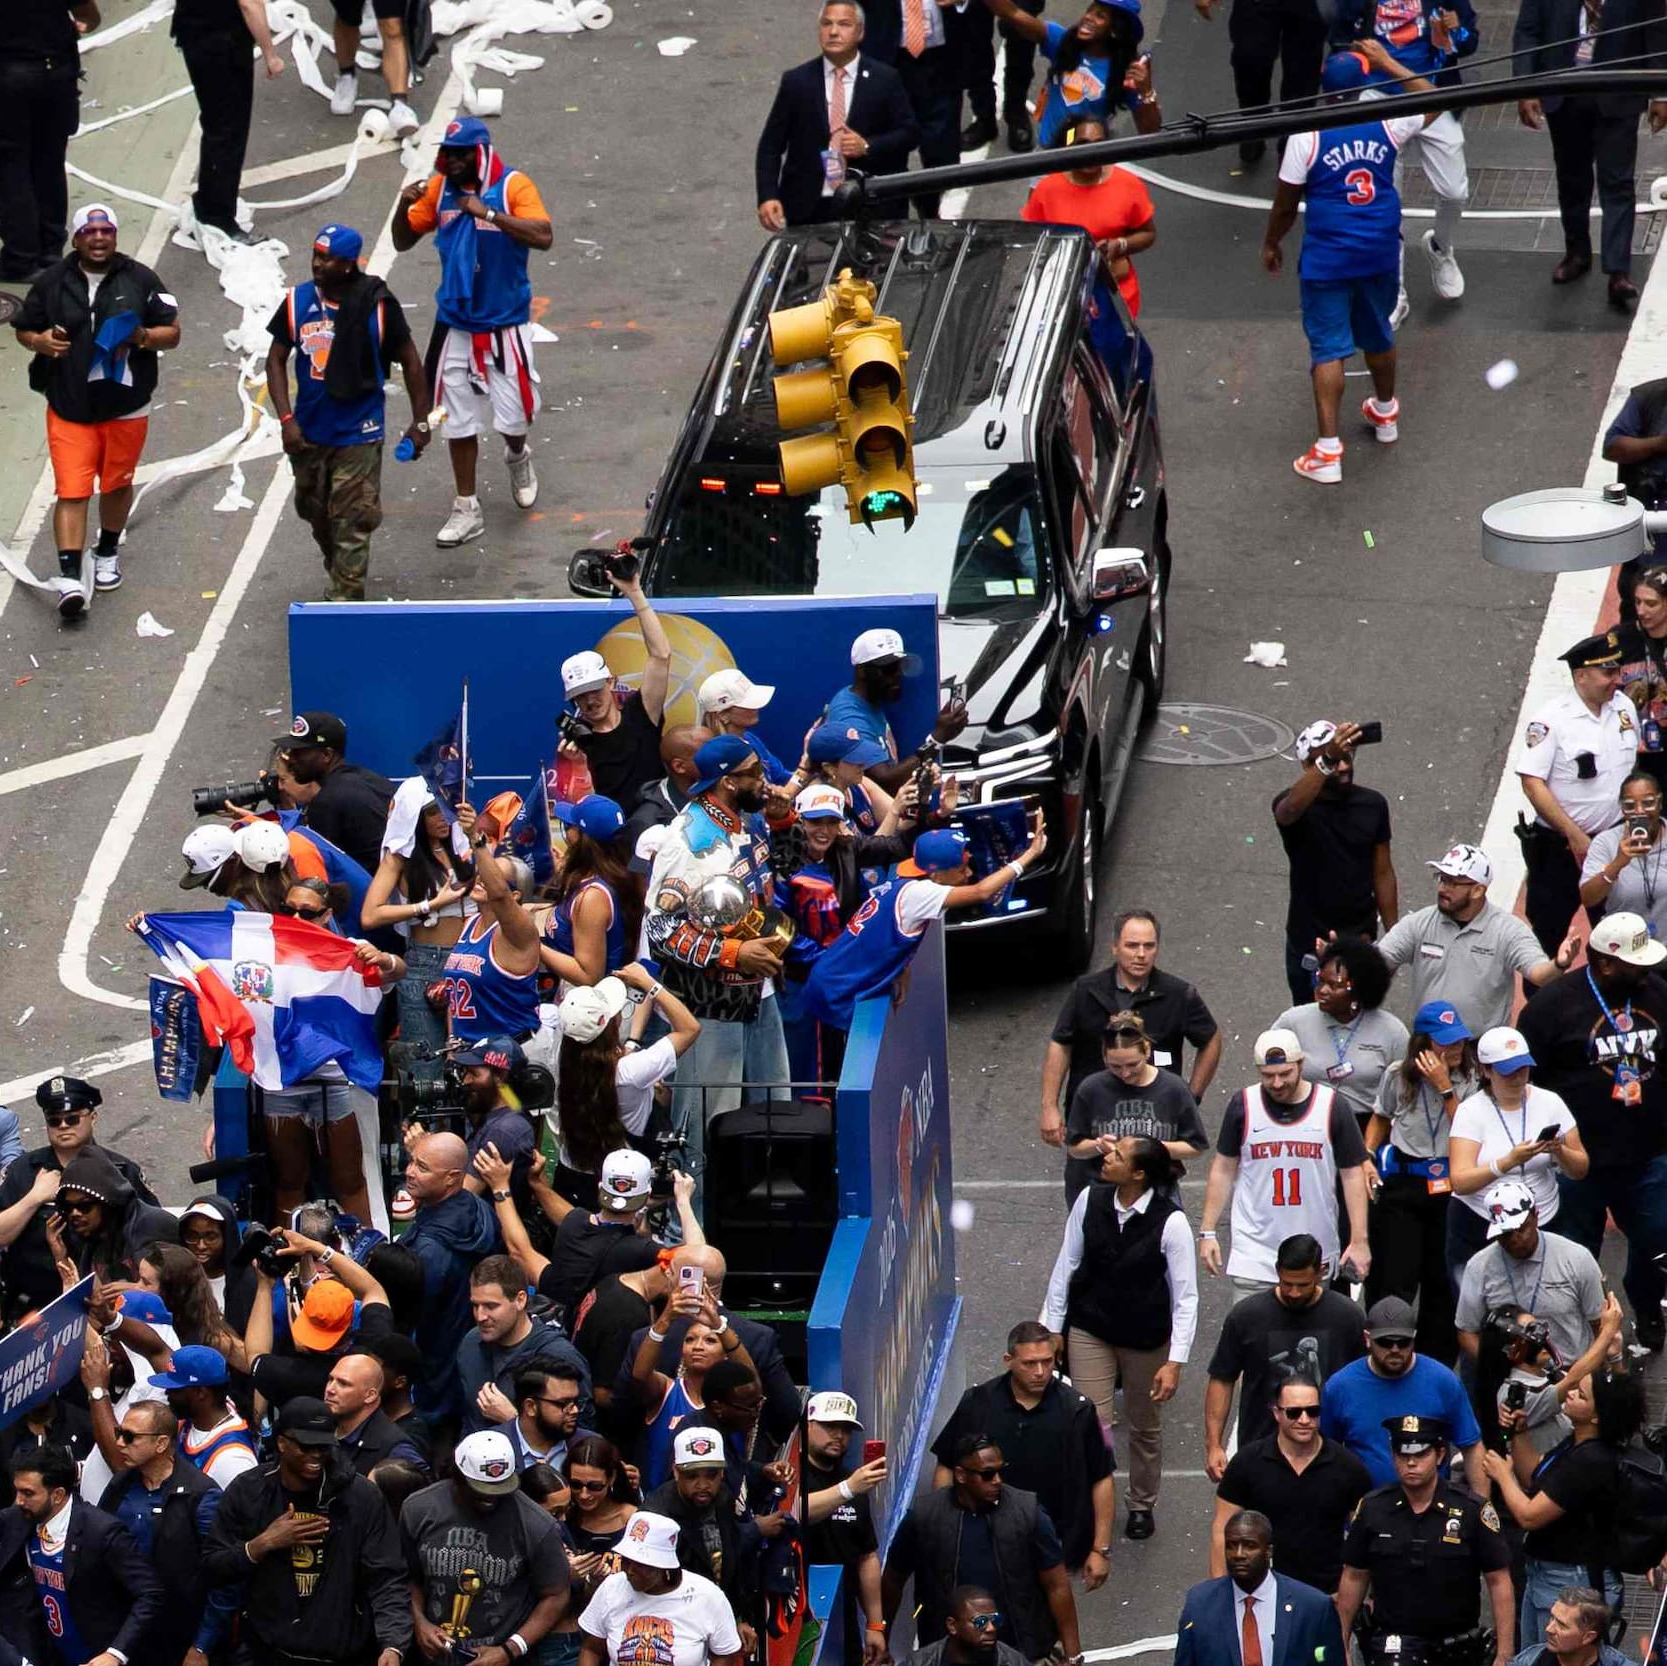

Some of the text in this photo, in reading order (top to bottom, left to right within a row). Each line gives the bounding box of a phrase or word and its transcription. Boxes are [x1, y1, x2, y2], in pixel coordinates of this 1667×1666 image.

[1322, 140, 1389, 171] STARKS
[1346, 168, 1375, 206] 3
[1250, 1140, 1324, 1161] NEW YORK
[1271, 1167, 1303, 1207] 11
[51, 1313, 85, 1356] YOU
[2, 1362, 52, 1415] FANS!
[447, 1525, 489, 1549] NBA
[42, 1593, 65, 1638] 3
